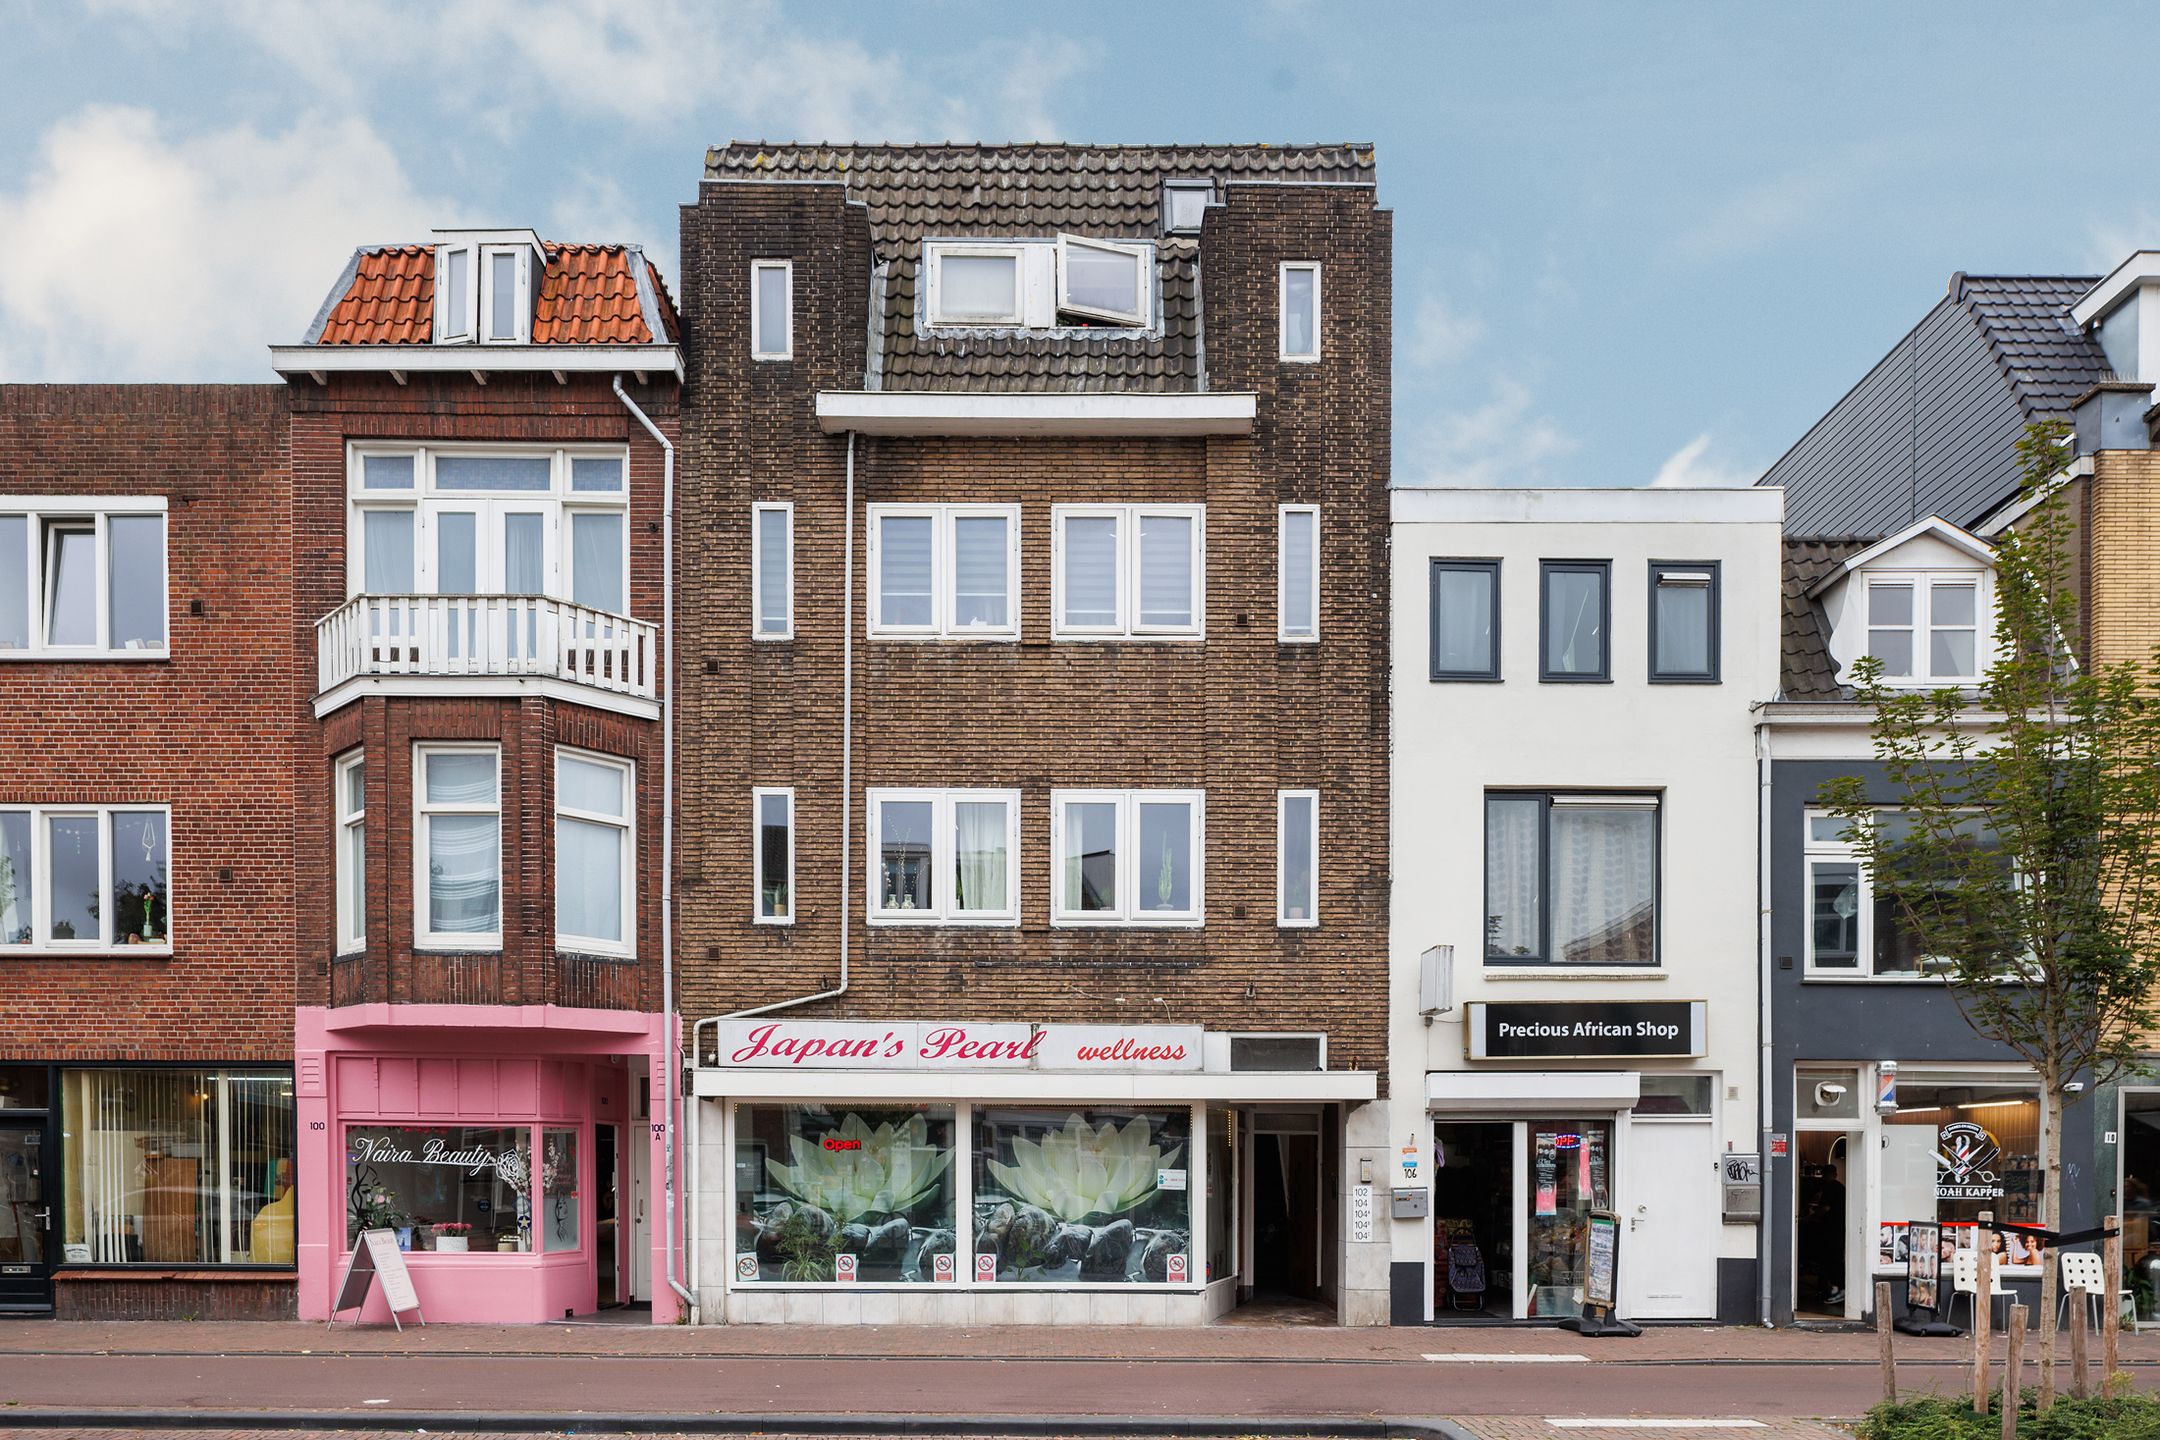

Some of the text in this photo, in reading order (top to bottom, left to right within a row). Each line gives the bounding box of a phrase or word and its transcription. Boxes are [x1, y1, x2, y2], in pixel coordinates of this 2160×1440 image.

[1499, 1021, 1679, 1039] Precious African Shop
[731, 1024, 1187, 1064] Japan's Pearl wellness
[310, 1121, 325, 1130] 100
[651, 1124, 666, 1132] 100
[655, 1132, 661, 1141] A
[823, 1138, 862, 1153] Open
[352, 1136, 494, 1177] Naira Beauty
[1404, 1168, 1418, 1179] 106
[1355, 1188, 1368, 1196] 102
[1934, 1188, 2004, 1197] NOAH KAPPER
[1355, 1199, 1368, 1207] 104
